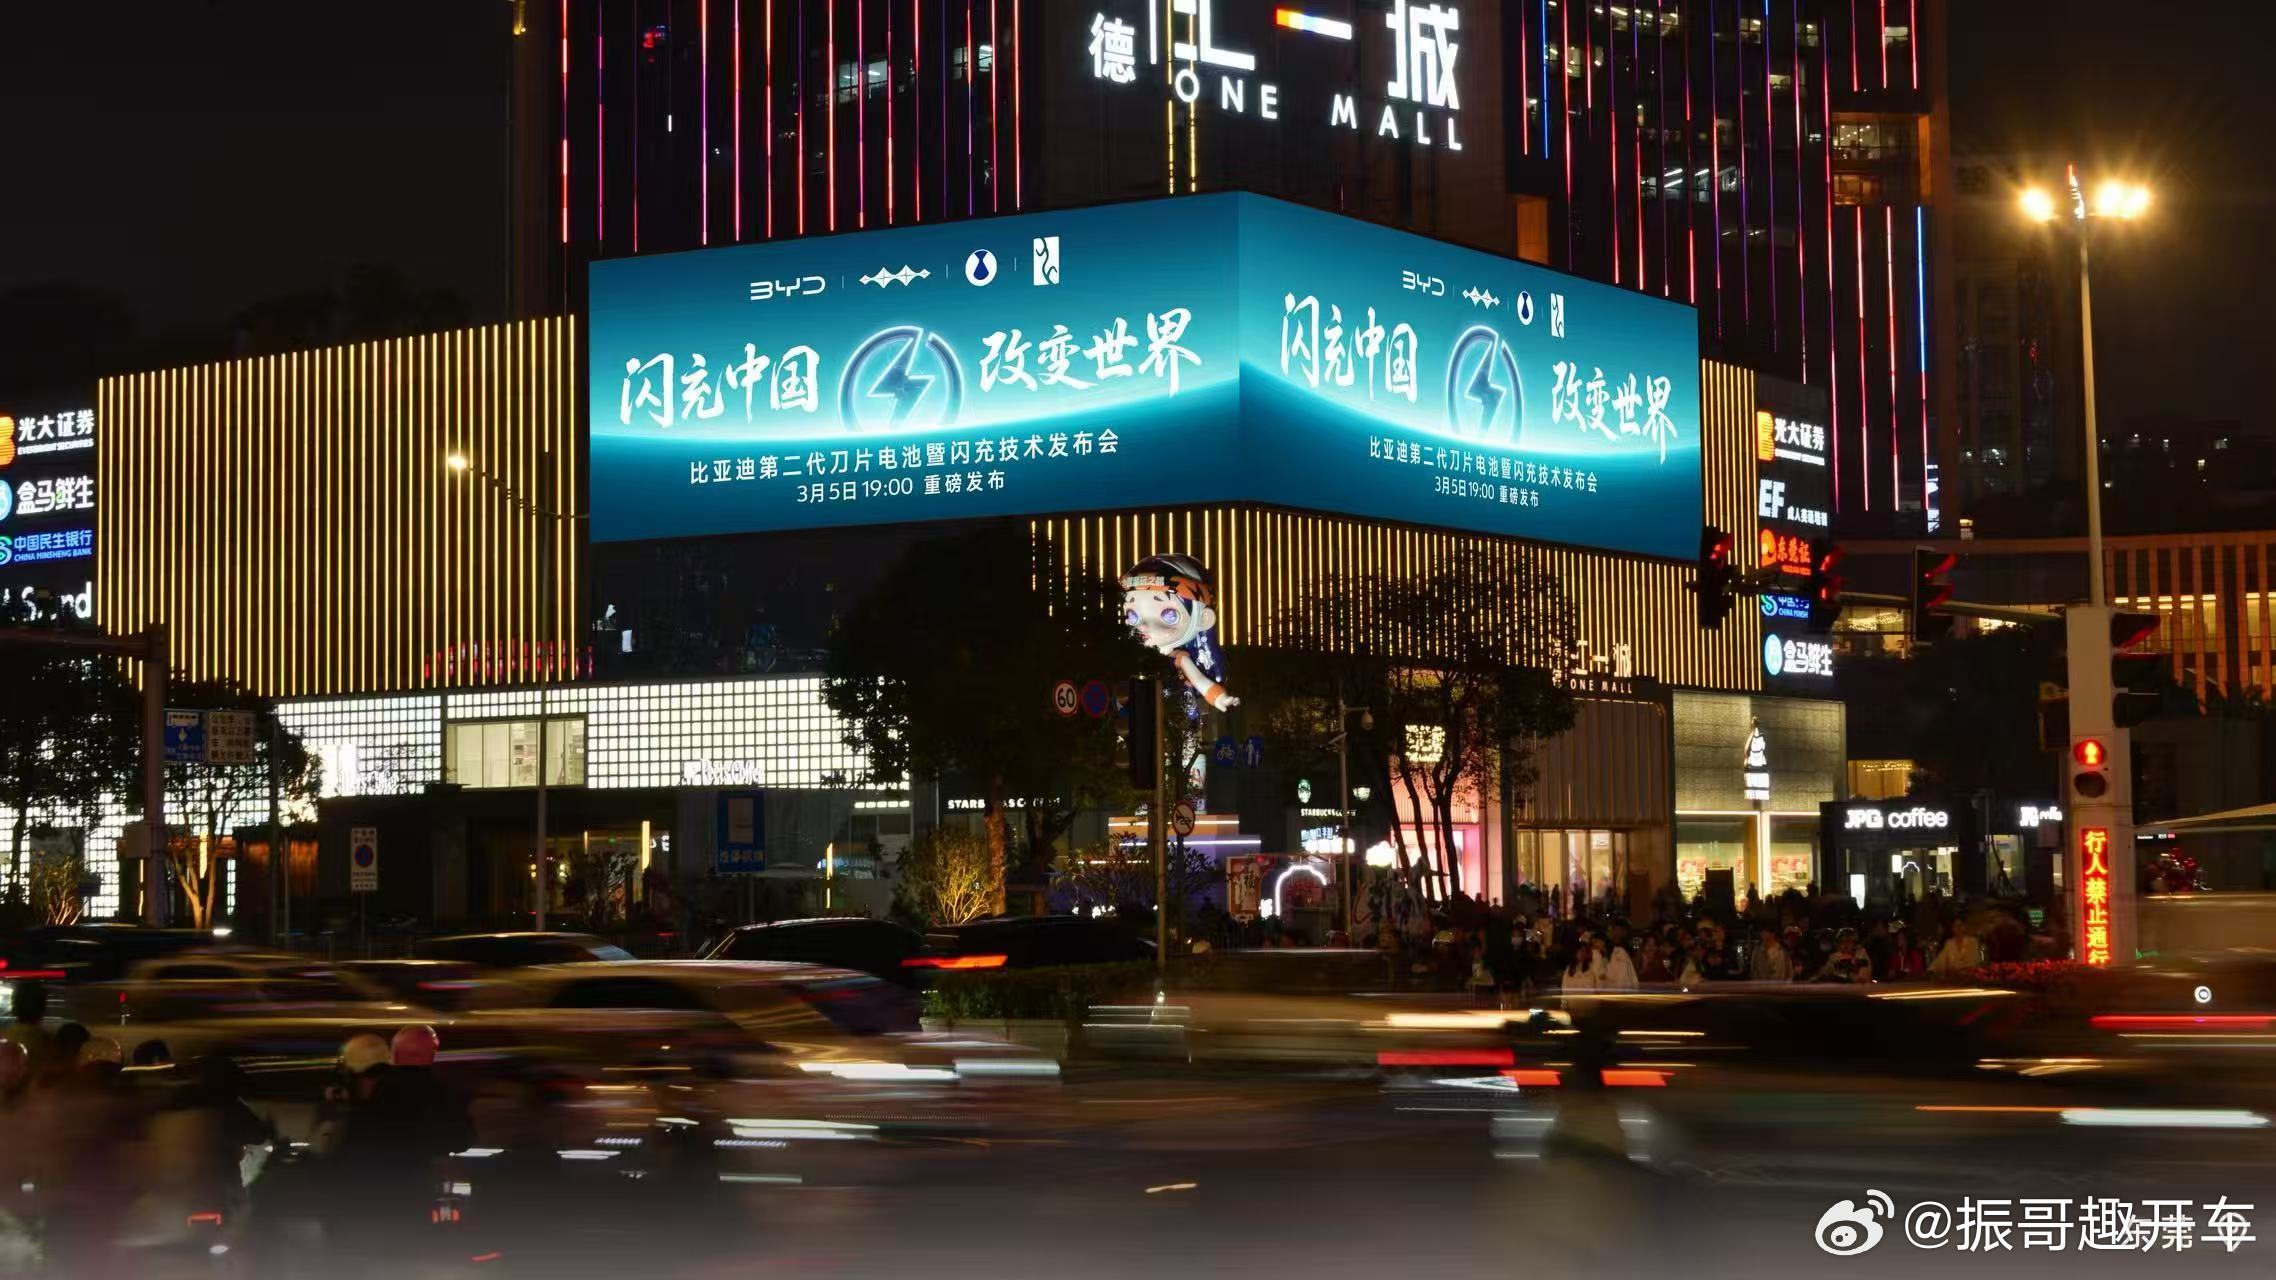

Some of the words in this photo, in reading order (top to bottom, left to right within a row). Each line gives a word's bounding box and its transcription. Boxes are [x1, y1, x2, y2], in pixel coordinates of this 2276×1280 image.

[1088, 12, 1137, 84] 德
[1174, 68, 1278, 120] ONE
[1330, 94, 1463, 151] MALL
[749, 275, 826, 301] BYD
[1402, 270, 1445, 297] BYD
[619, 342, 821, 428] 闪充中国
[979, 307, 1203, 398] 改变世界
[1280, 291, 1419, 404] 闪充中国
[1551, 360, 1679, 465] 改变世界
[18, 408, 95, 442] 光大证券
[1774, 417, 1825, 451] 光大证券
[689, 427, 1120, 485] 比亚迪第二代刀片电池暨闪充技术发布会
[1369, 434, 1599, 494] 比亚迪第二代刀片电池暨闪充技术发布会
[16, 475, 95, 515] 盒马鲜生
[796, 477, 914, 504] 3月5日19:00
[923, 469, 1006, 497] 重磅发布
[1434, 479, 1496, 501] 3月5日19:00
[1498, 484, 1540, 509] 重磅发布
[1758, 479, 1786, 519] EF
[14, 529, 93, 552] 中国民生银行
[14, 552, 36, 562] CHINA
[36, 549, 72, 560] MINSHENG
[72, 547, 93, 557] BANK
[1783, 639, 1834, 677] 盒马鲜生
[1057, 687, 1076, 708] 60
[1569, 678, 1595, 692] ONE
[1601, 680, 1633, 694] MALL
[1844, 808, 1884, 829] JPG
[1887, 806, 1949, 828] coffee
[2084, 830, 2110, 965] 行人禁止通行
